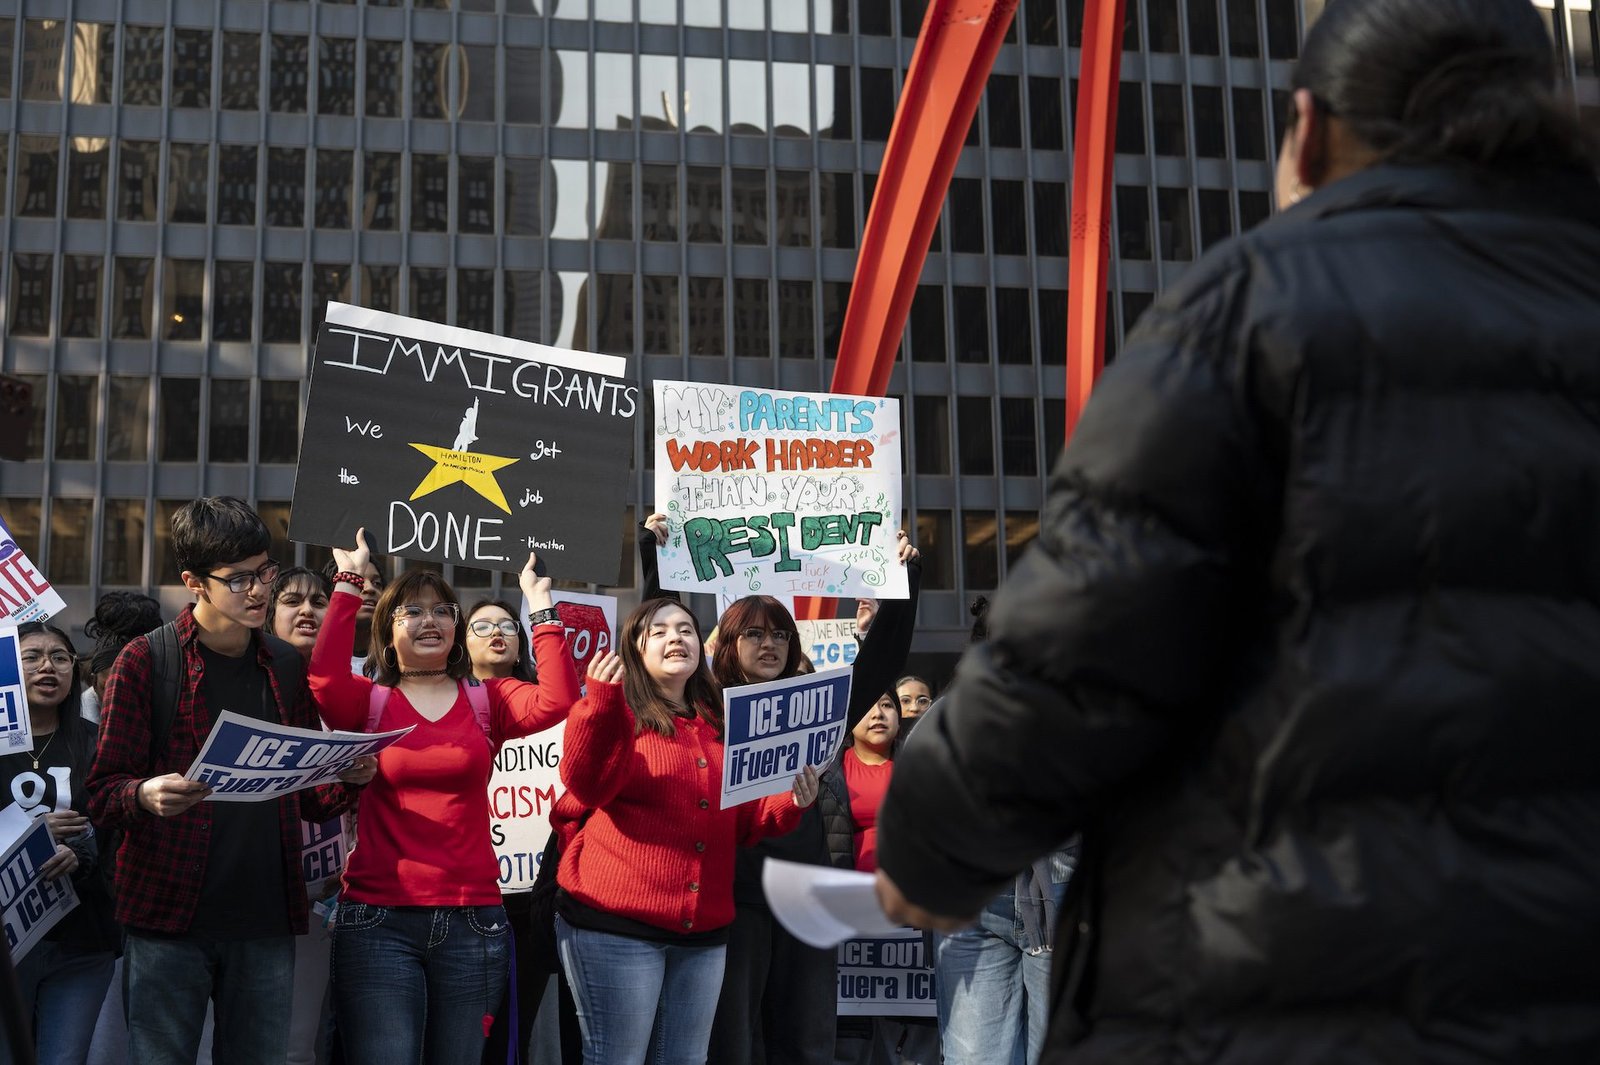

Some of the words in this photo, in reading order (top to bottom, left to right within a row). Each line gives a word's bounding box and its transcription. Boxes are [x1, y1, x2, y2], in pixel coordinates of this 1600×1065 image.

[323, 328, 638, 417] IMMIGRANTS
[664, 387, 729, 434] MY
[739, 391, 876, 433] PARENTS
[441, 452, 482, 464] HAMILTON
[530, 440, 562, 461] get
[666, 438, 760, 473] WORK
[765, 438, 874, 472] HARDER
[338, 468, 360, 485] the
[519, 489, 544, 508] job
[678, 475, 767, 512] THAN
[782, 475, 857, 512] YOUR
[388, 501, 511, 562] DONE.
[565, 626, 608, 660] TOP
[816, 623, 832, 639] WE
[836, 622, 856, 637] NEE
[812, 643, 856, 666] ICE
[749, 695, 784, 738] ICE
[788, 684, 834, 730] OUT!
[234, 735, 301, 768] ICE
[302, 740, 379, 768] OUT!
[494, 742, 560, 772] NDING
[730, 742, 800, 786] ¡Fuera
[0, 847, 36, 907] UT!
[303, 840, 342, 883] CE!
[838, 942, 874, 965] ICE
[881, 942, 924, 968] OUT
[838, 972, 898, 999] uera
